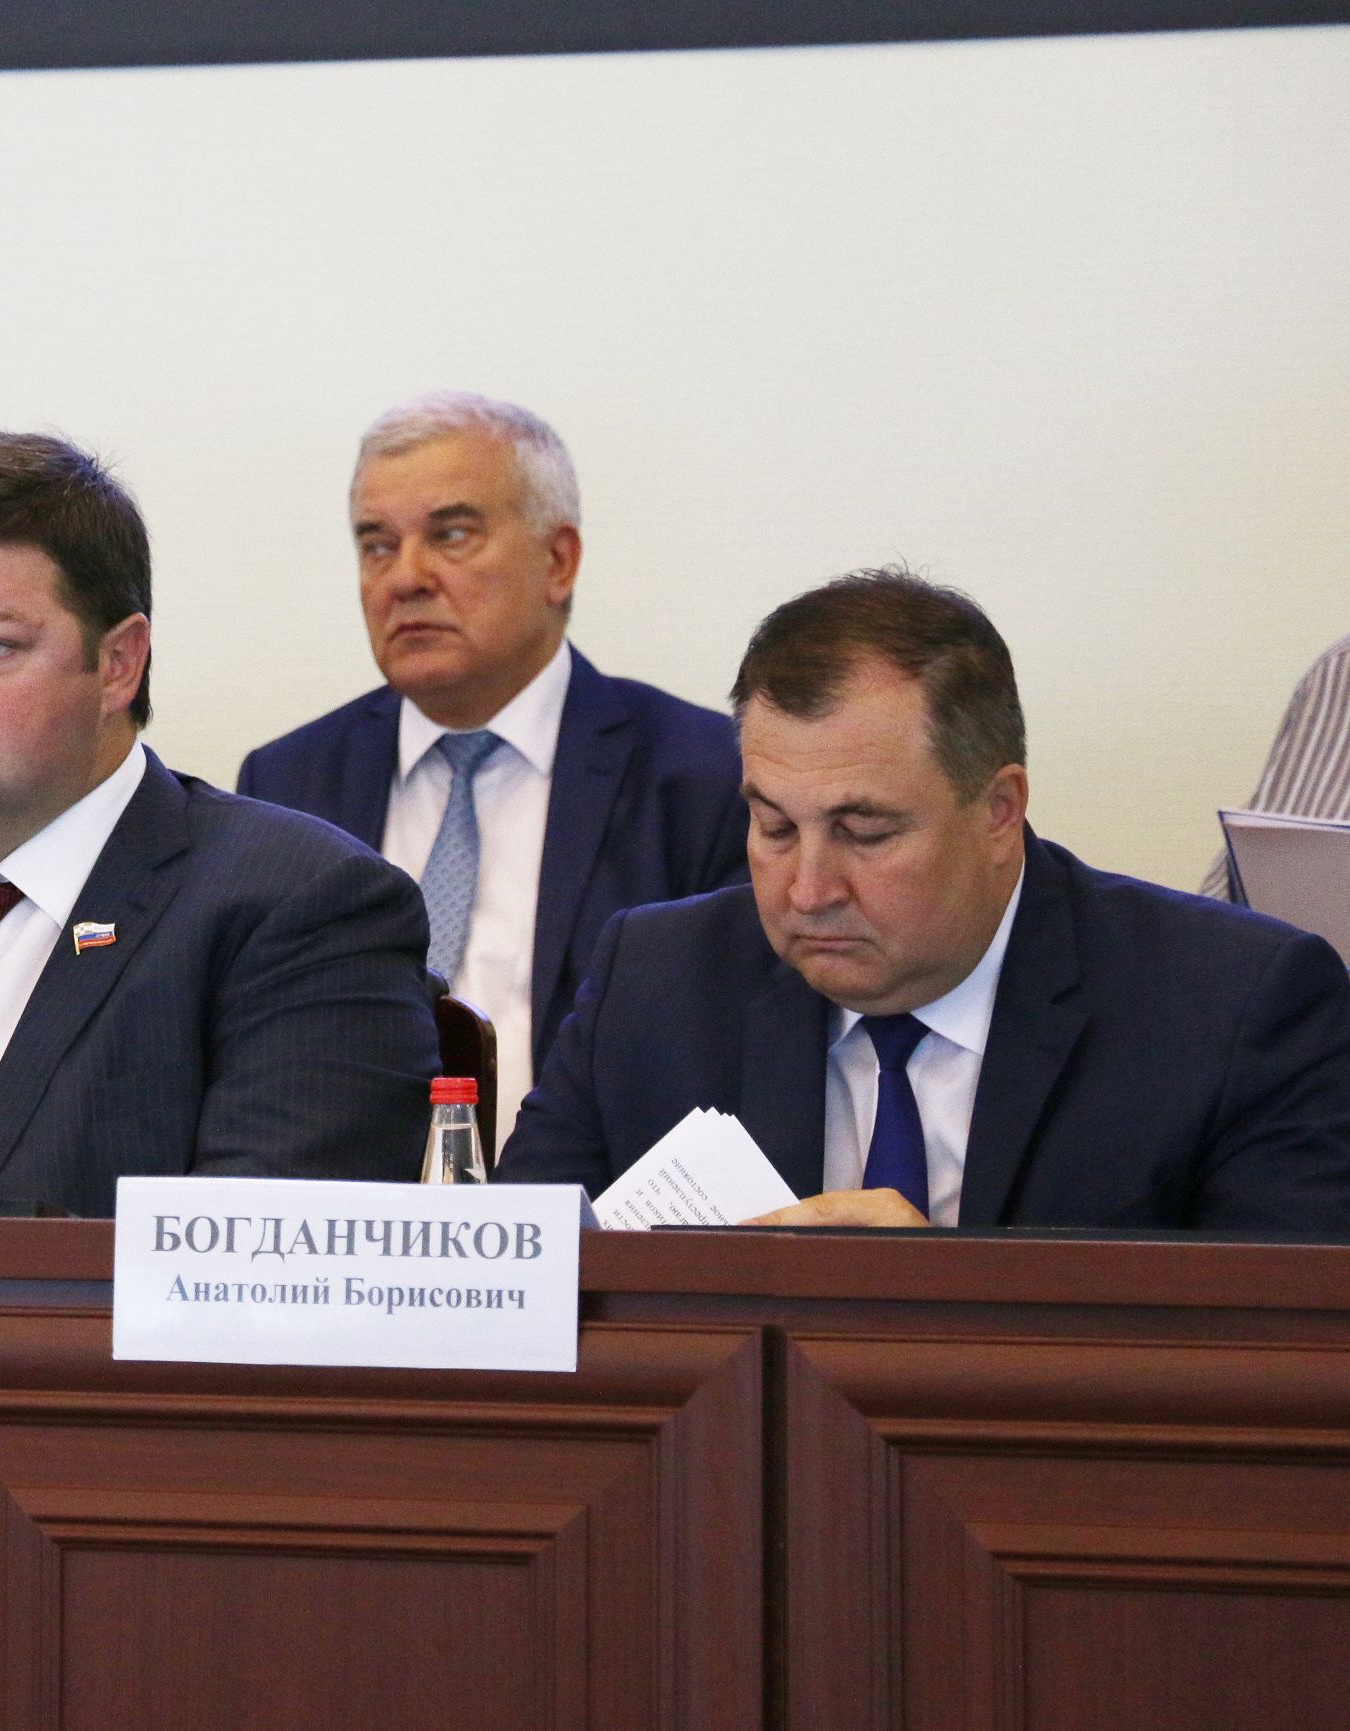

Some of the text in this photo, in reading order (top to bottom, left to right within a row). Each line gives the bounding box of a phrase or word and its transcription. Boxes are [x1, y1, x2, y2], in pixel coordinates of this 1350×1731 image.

[645, 1199, 666, 1225] тиков
[647, 1178, 689, 1226] агаю, что
[671, 1158, 730, 1227] ьное состояние
[624, 1199, 652, 1231] пления
[151, 1215, 543, 1261] БОГДАНЧИКОВ
[166, 1274, 526, 1315] Анатолий Борисович
